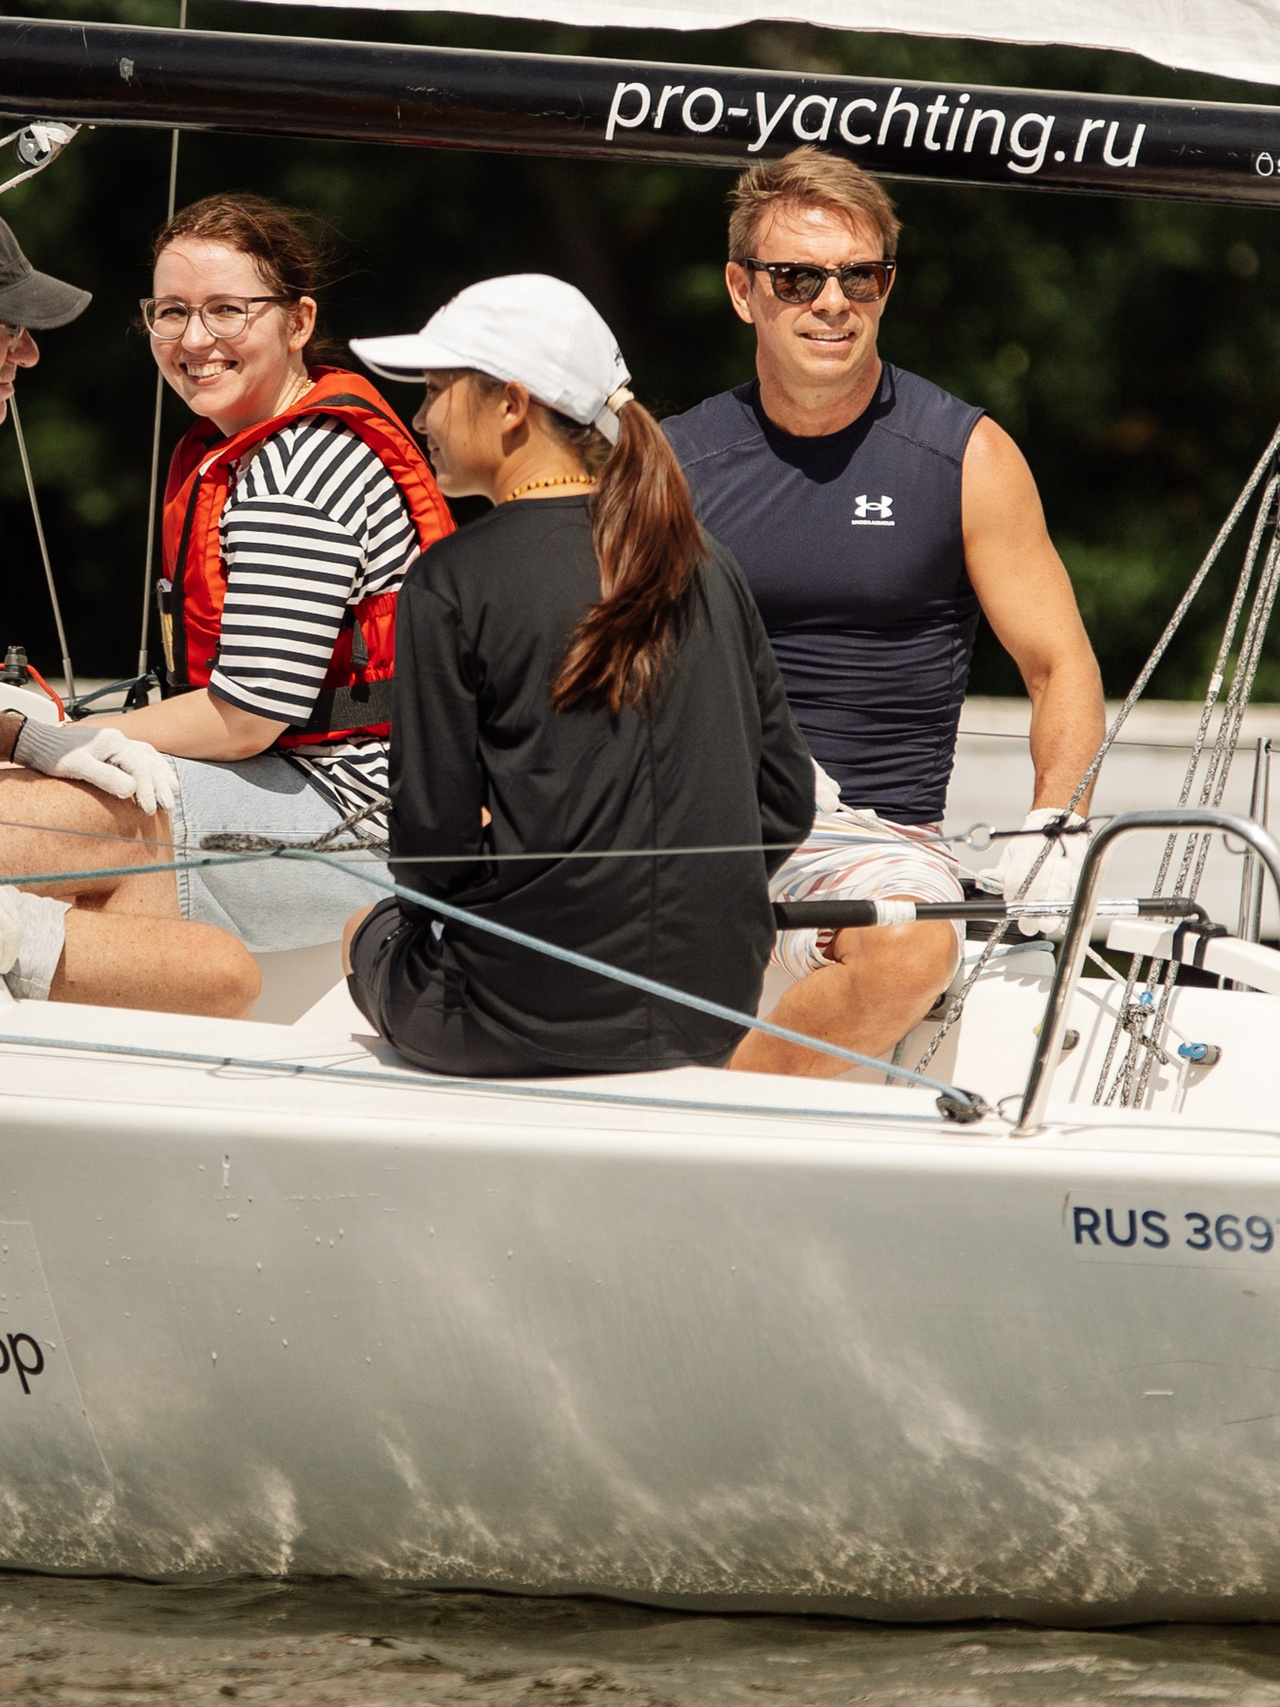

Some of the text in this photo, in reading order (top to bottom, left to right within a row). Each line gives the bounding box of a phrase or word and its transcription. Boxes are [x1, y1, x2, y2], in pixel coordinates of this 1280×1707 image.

[605, 82, 1146, 174] pro-yachting.ru
[1073, 1206, 1280, 1254] RUS 369
